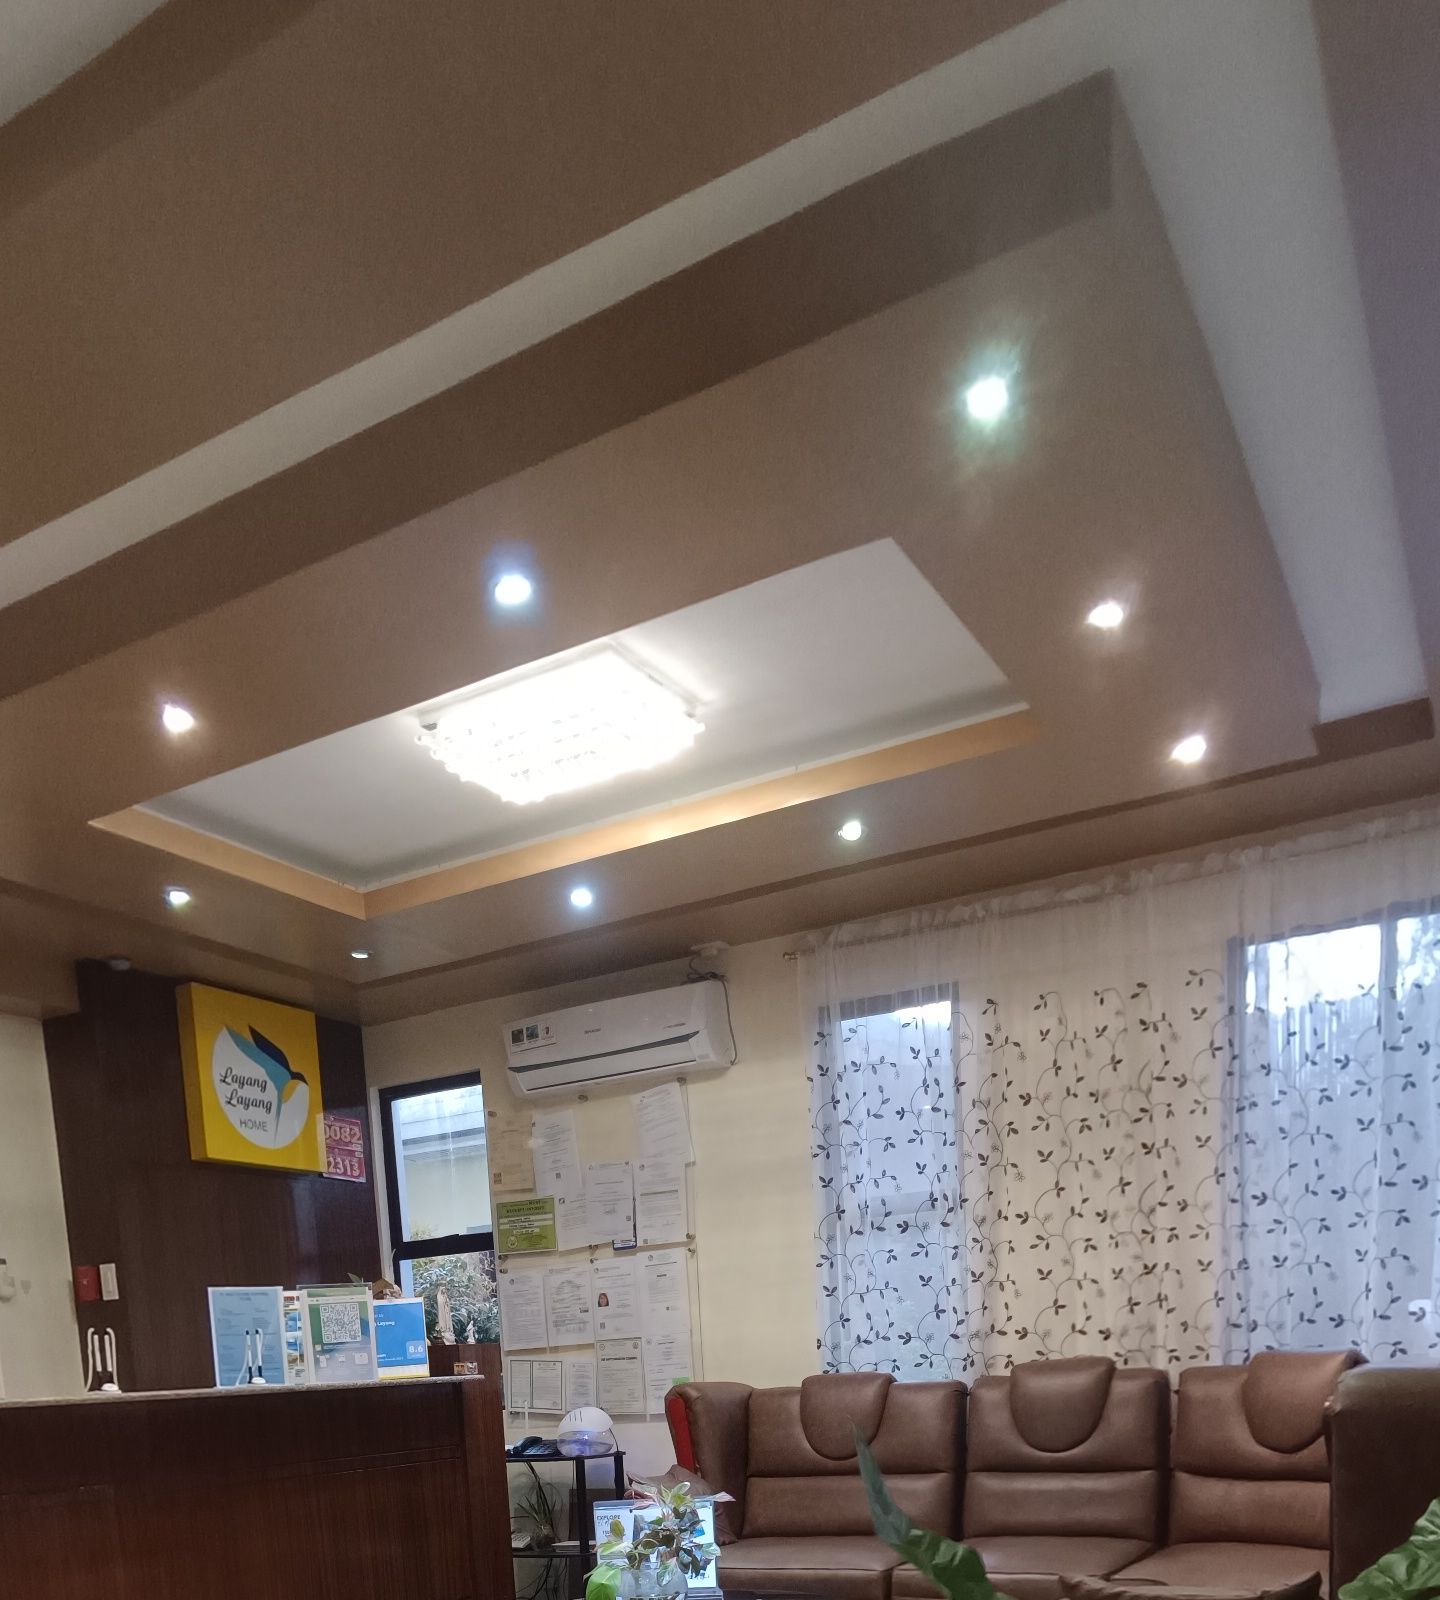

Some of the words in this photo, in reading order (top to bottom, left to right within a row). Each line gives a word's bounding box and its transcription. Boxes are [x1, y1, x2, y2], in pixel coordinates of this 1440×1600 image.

[219, 1067, 267, 1094] Layang
[225, 1089, 273, 1115] Layang
[240, 1118, 269, 1132] HOME
[408, 1345, 424, 1353] 8.6
